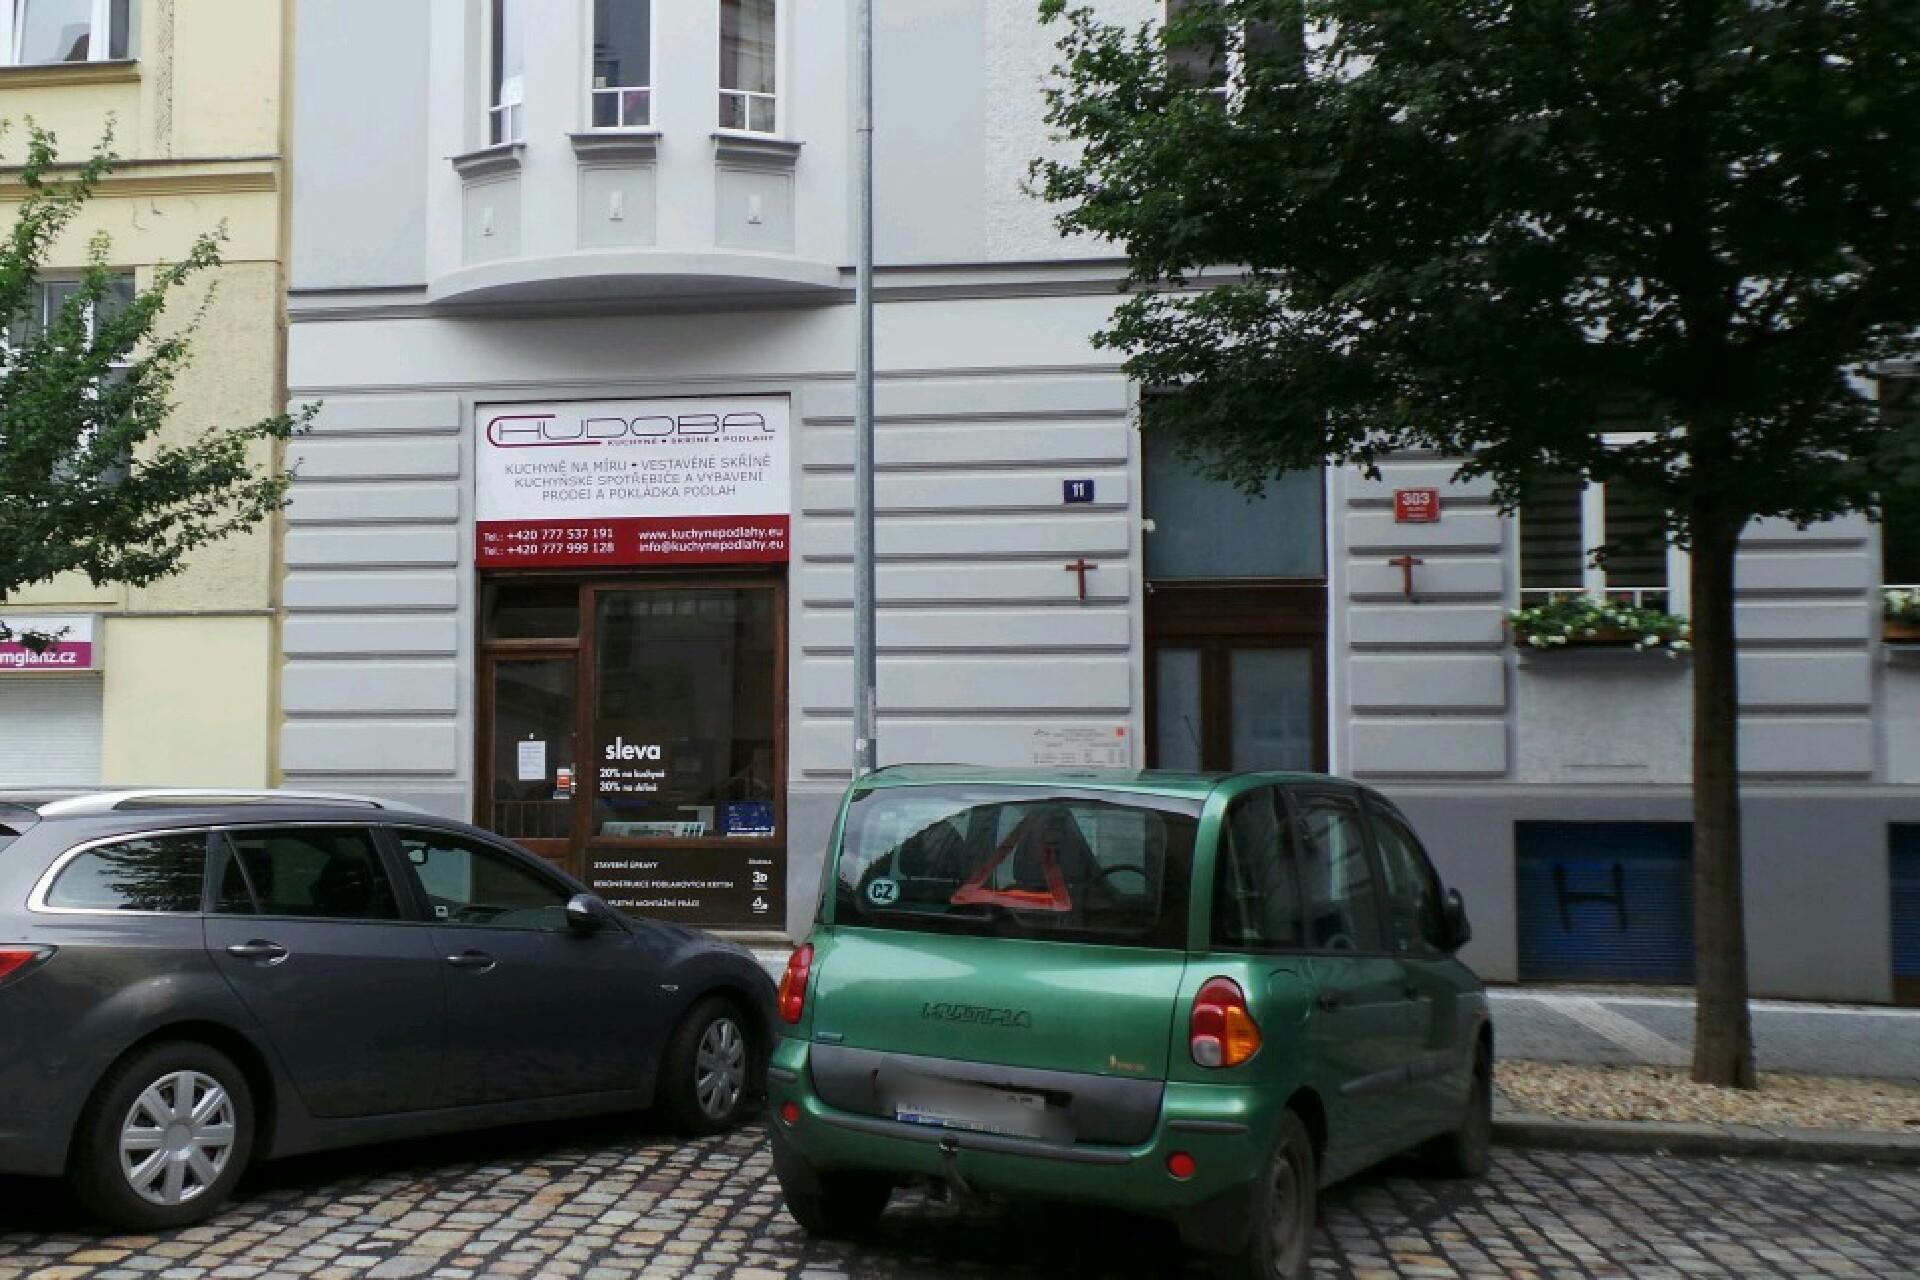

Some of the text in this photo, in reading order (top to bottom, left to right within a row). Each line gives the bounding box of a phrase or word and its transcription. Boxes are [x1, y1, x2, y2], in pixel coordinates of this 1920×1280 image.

[486, 412, 776, 448] CHUDOBA
[504, 459, 566, 475] KUCHYNĚ
[570, 461, 589, 473] NA
[593, 457, 627, 472] MÍRU
[685, 473, 693, 482] A
[542, 484, 736, 501] PRODEJ A POKLÁDKA PODLAH
[1071, 482, 1085, 498] 11
[506, 529, 538, 540] +420
[542, 528, 564, 540] 777
[566, 528, 589, 540] 537
[593, 528, 613, 539] 191
[506, 543, 538, 555] +420
[542, 542, 564, 554] 777
[605, 736, 661, 760] sleva
[873, 883, 893, 899] CZ
